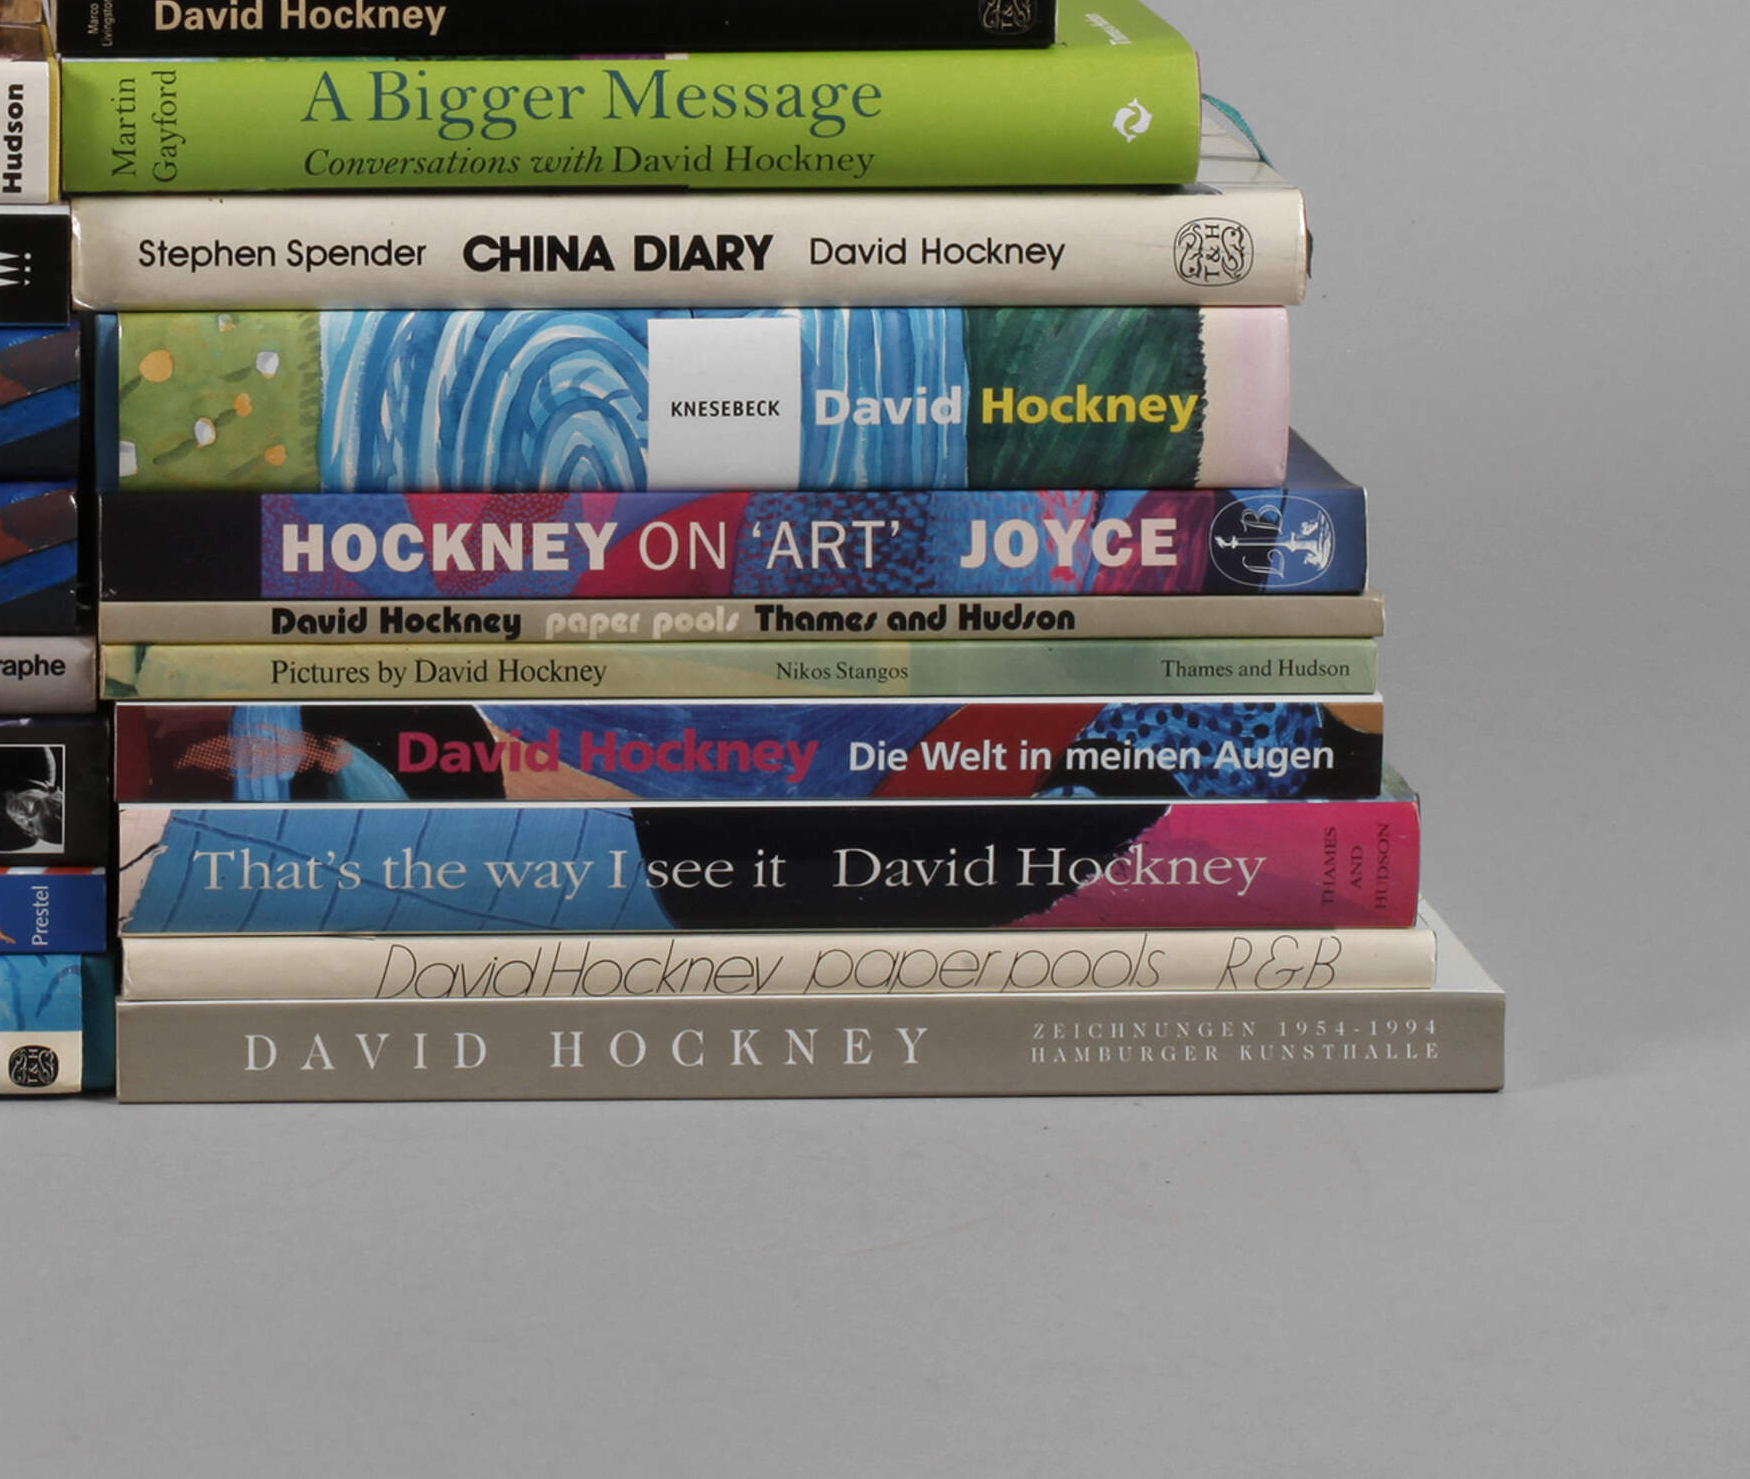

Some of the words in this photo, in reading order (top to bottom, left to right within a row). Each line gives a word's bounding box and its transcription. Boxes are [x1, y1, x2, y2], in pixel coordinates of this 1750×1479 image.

[87, 3, 99, 35] Marco
[154, 0, 263, 31] David
[152, 68, 186, 183] Gayford
[300, 70, 353, 122] A
[368, 69, 586, 141] Bigger
[602, 68, 884, 138] Message
[3, 82, 24, 194] Hudson
[110, 76, 137, 178] Martin
[303, 147, 521, 177] Conversations
[531, 145, 603, 174] with
[611, 145, 713, 174] David
[724, 145, 876, 181] Hockney
[138, 238, 276, 273] Stephen
[286, 238, 427, 273] Spender
[463, 235, 614, 273] CHINA
[634, 235, 773, 272] DIARY
[809, 235, 907, 267] David
[921, 235, 1066, 275] Hockney
[671, 400, 780, 417] KNESEBECK
[815, 386, 962, 426] David
[982, 385, 1198, 432] Hockney
[282, 523, 618, 572] HOCKNEY
[639, 521, 726, 570] ON
[960, 518, 1177, 569] JOYCE
[271, 607, 368, 635] David
[380, 607, 521, 641] Hockney
[546, 608, 640, 639] paper
[653, 606, 740, 638] pools
[756, 604, 877, 632] Thames
[887, 604, 947, 630] and
[959, 603, 1075, 631] Hudson
[271, 660, 370, 685] Pictures
[377, 660, 407, 689] by
[415, 659, 488, 684] David
[498, 659, 607, 687] Hockney
[775, 662, 831, 679] Nikos
[836, 662, 908, 683] Stangos
[1160, 659, 1233, 678] Thames
[1236, 659, 1272, 677] and
[1277, 658, 1350, 677] Hudson
[397, 729, 559, 773] David
[581, 729, 817, 783] Hockney
[849, 742, 907, 771] Die
[920, 741, 1006, 770] Welt
[1020, 741, 1052, 770] in
[1065, 740, 1202, 770] meinen
[1214, 741, 1334, 777] Augen
[193, 849, 362, 890] That's
[383, 848, 466, 889] the
[484, 860, 594, 899] way
[608, 850, 629, 888] I
[647, 860, 733, 888] see
[752, 849, 786, 887] it
[833, 845, 997, 888] David
[1016, 844, 1266, 895] Hockney
[1321, 826, 1336, 907] THAMES
[1349, 844, 1363, 889] AND
[1376, 823, 1390, 909] HUDSON
[32, 885, 48, 946] Prestel
[376, 944, 542, 999] David
[543, 940, 783, 996] Hockney
[803, 947, 1001, 993] paper
[1001, 933, 1166, 992] pools
[1216, 935, 1343, 990] R&B
[244, 1032, 487, 1071] DAVID
[551, 1028, 929, 1068] HOCKNEY
[1032, 1021, 1256, 1039] ZEICHNUNGEN
[1278, 1019, 1436, 1037] 1954-1994
[1031, 1046, 1219, 1063] HAMBURGER
[1239, 1042, 1439, 1061] KUNSTHALLE
